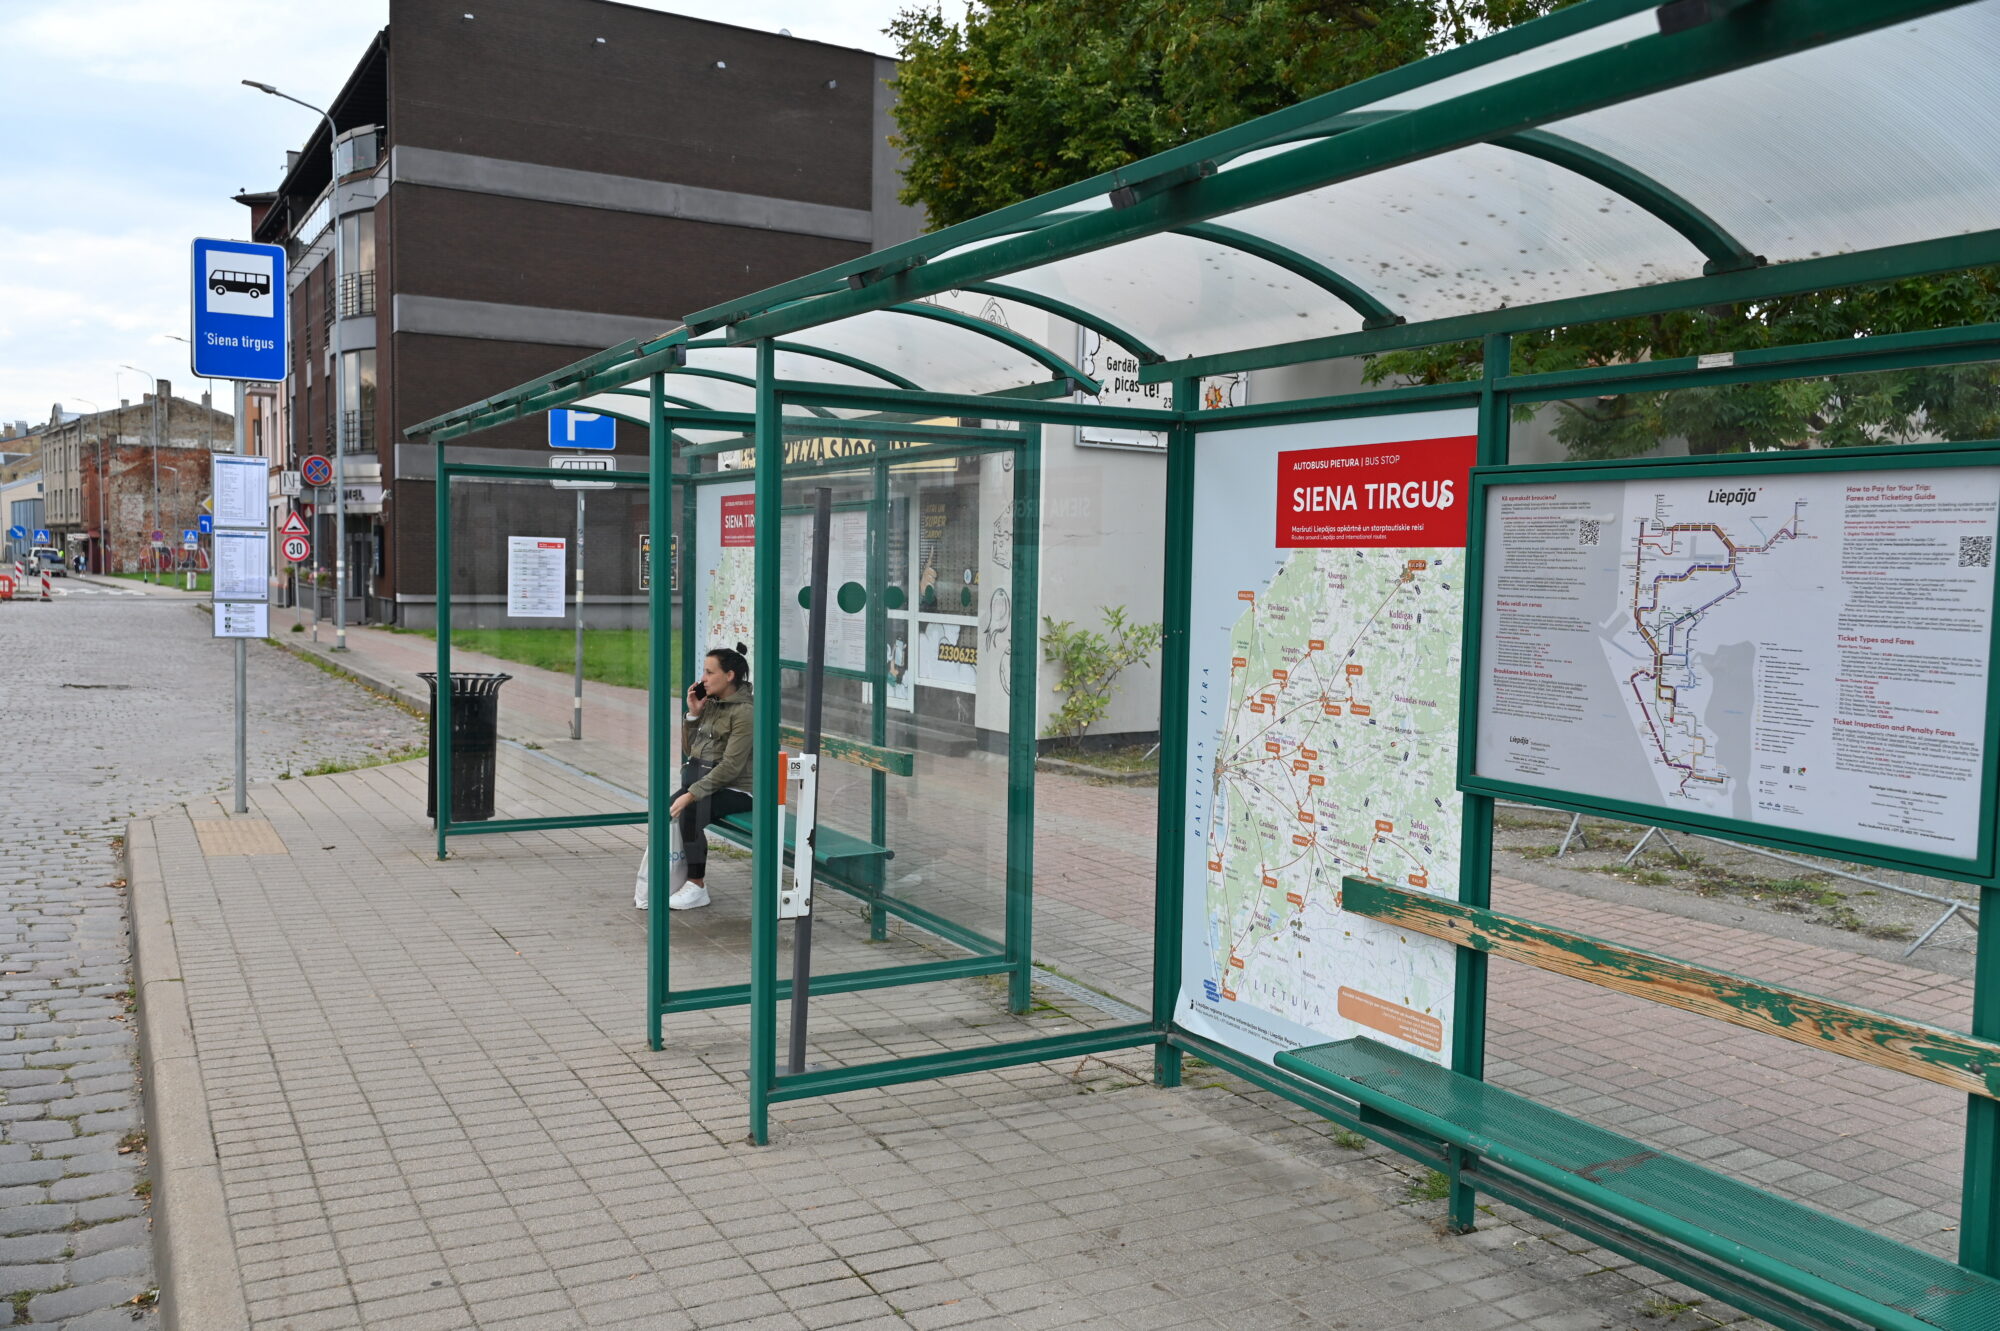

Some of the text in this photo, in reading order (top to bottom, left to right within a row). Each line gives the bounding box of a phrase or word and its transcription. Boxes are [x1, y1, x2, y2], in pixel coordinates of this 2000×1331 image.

[208, 332, 274, 351] Siena tirgus
[1115, 377, 1139, 393] picas
[567, 409, 601, 441] P
[1293, 455, 1400, 470] AUTOBUSU PIETURA BUS STOP
[1292, 479, 1454, 512] SIENA TIRGUS
[1708, 488, 1757, 505] Liepāja
[725, 515, 743, 528] SIENA
[289, 542, 302, 555] 30
[1859, 636, 1878, 644] Types
[1833, 718, 1853, 726] Ticket
[1854, 720, 1889, 729] Inspection
[1907, 726, 1933, 735] Penalty
[1510, 736, 1529, 745] Liepāja
[790, 762, 800, 770] DS
